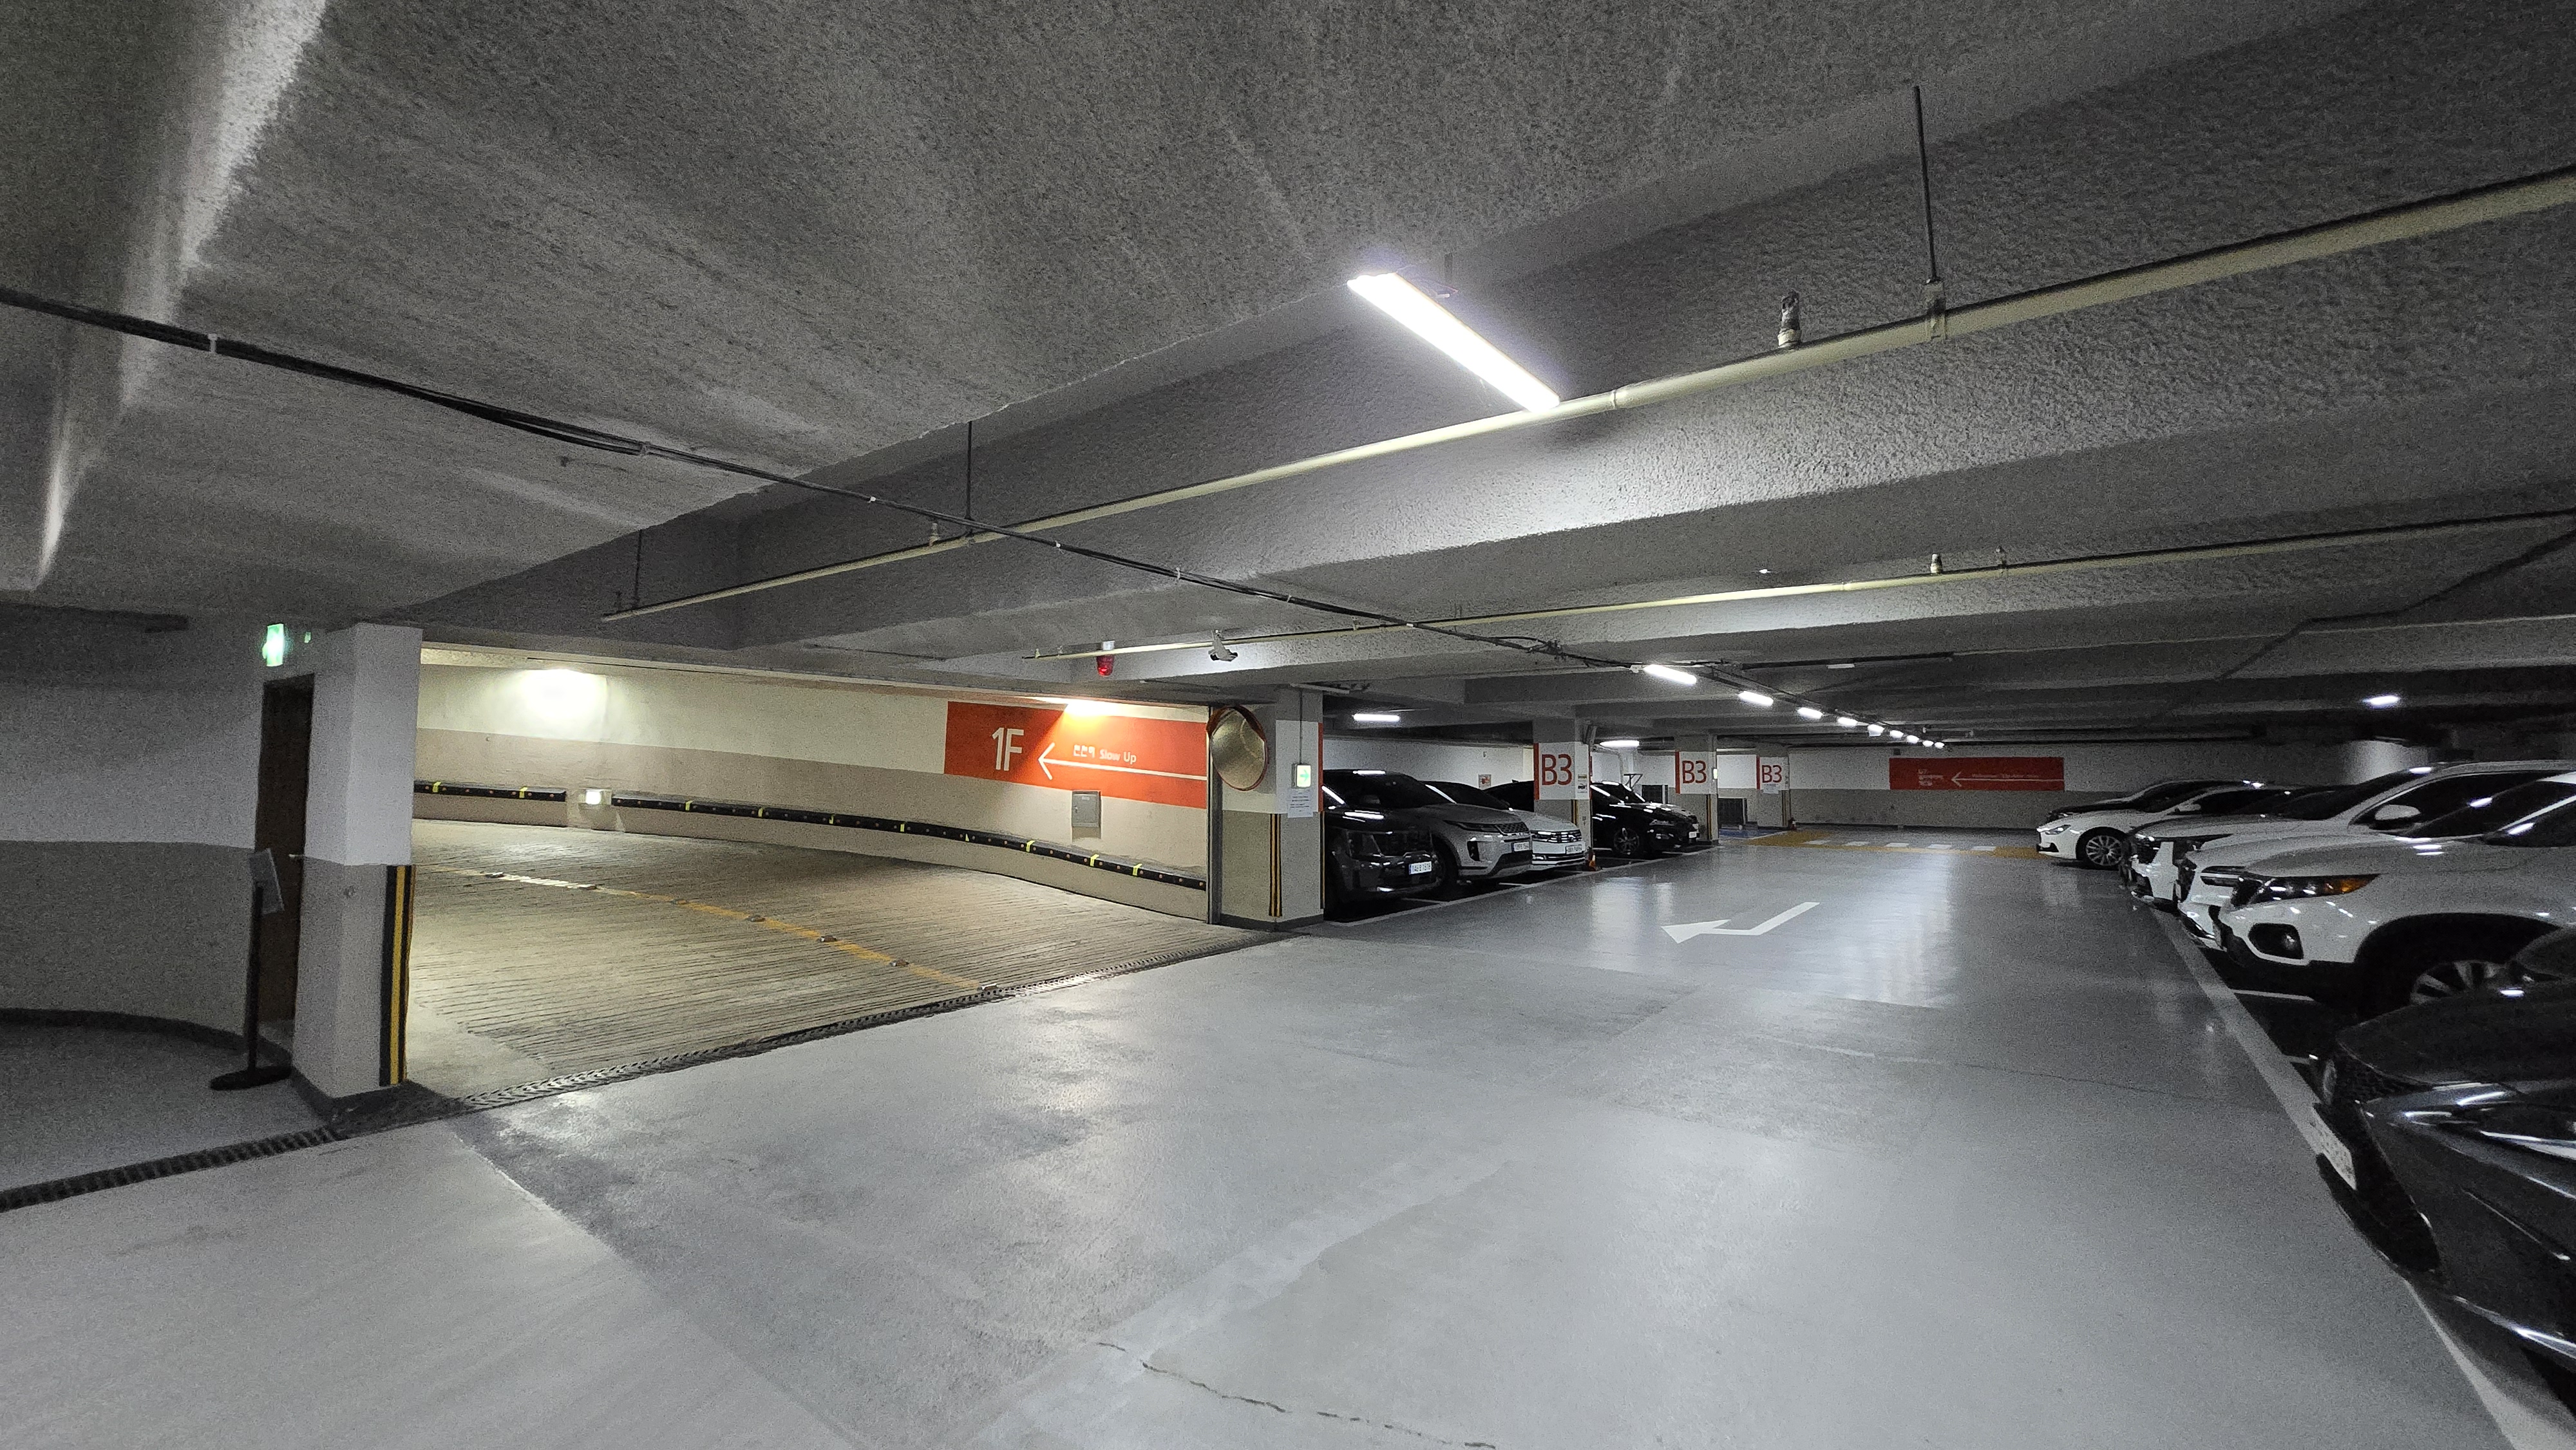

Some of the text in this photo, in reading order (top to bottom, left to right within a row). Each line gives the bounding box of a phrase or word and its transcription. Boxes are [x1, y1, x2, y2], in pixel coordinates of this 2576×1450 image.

[992, 728, 1024, 771] 1F
[1099, 749, 1121, 761] Slow
[1123, 751, 1137, 765] Up
[1541, 754, 1573, 786] B3
[1682, 760, 1707, 784] B3
[1761, 764, 1783, 783] B3
